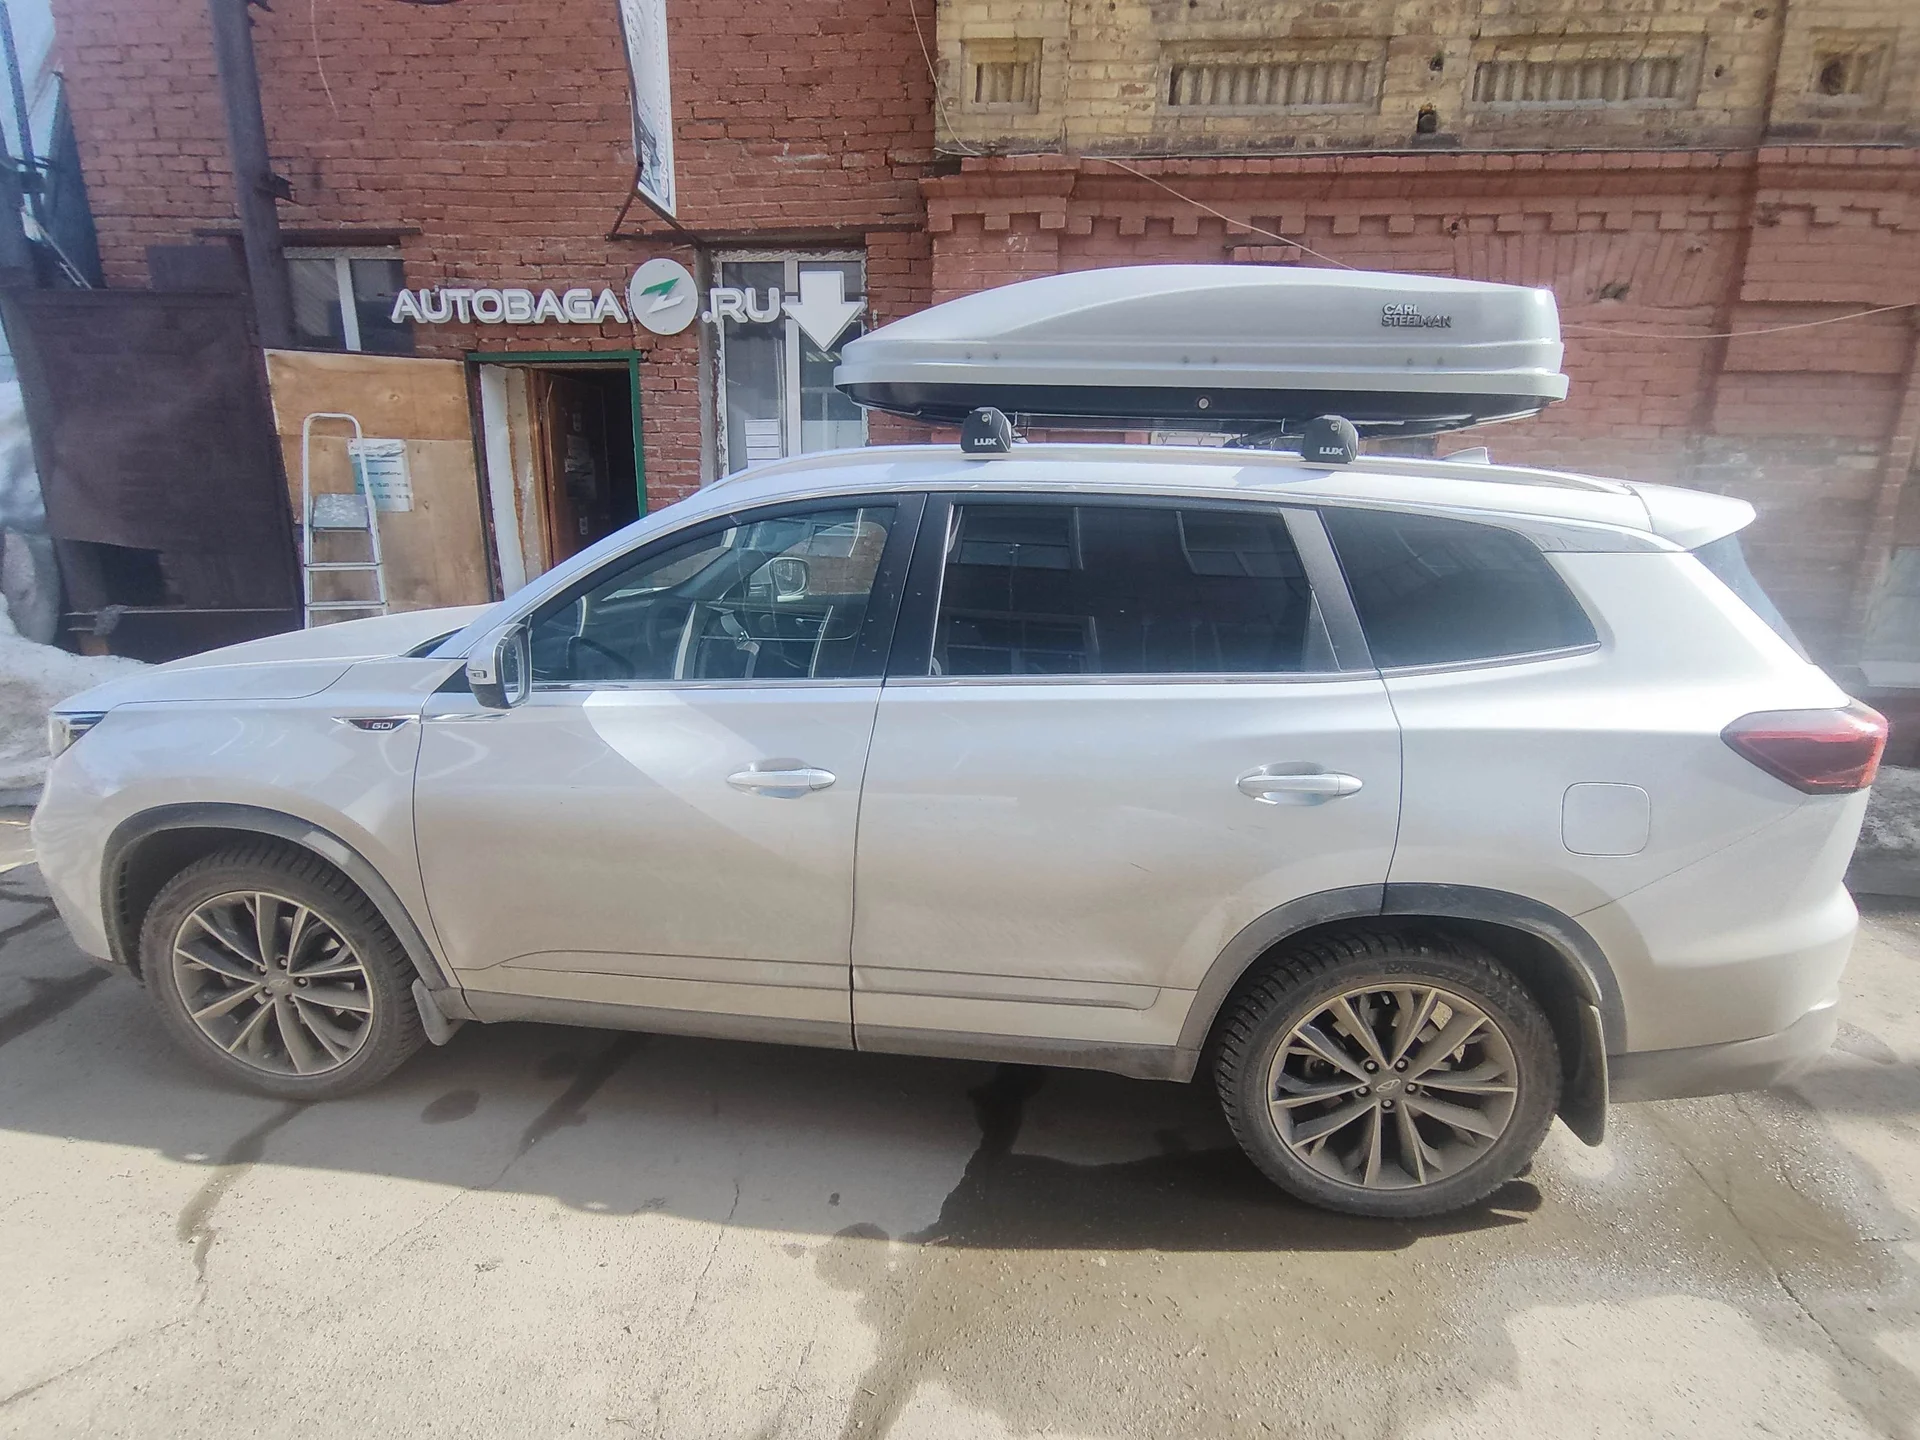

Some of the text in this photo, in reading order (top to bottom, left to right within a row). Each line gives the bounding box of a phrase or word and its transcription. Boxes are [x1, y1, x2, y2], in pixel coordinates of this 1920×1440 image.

[391, 287, 781, 325] AUTOBAGA .RU
[1382, 303, 1421, 316] CARL
[1381, 314, 1452, 328] STEELMAN
[974, 437, 998, 446] LUX
[1319, 446, 1344, 456] LUX
